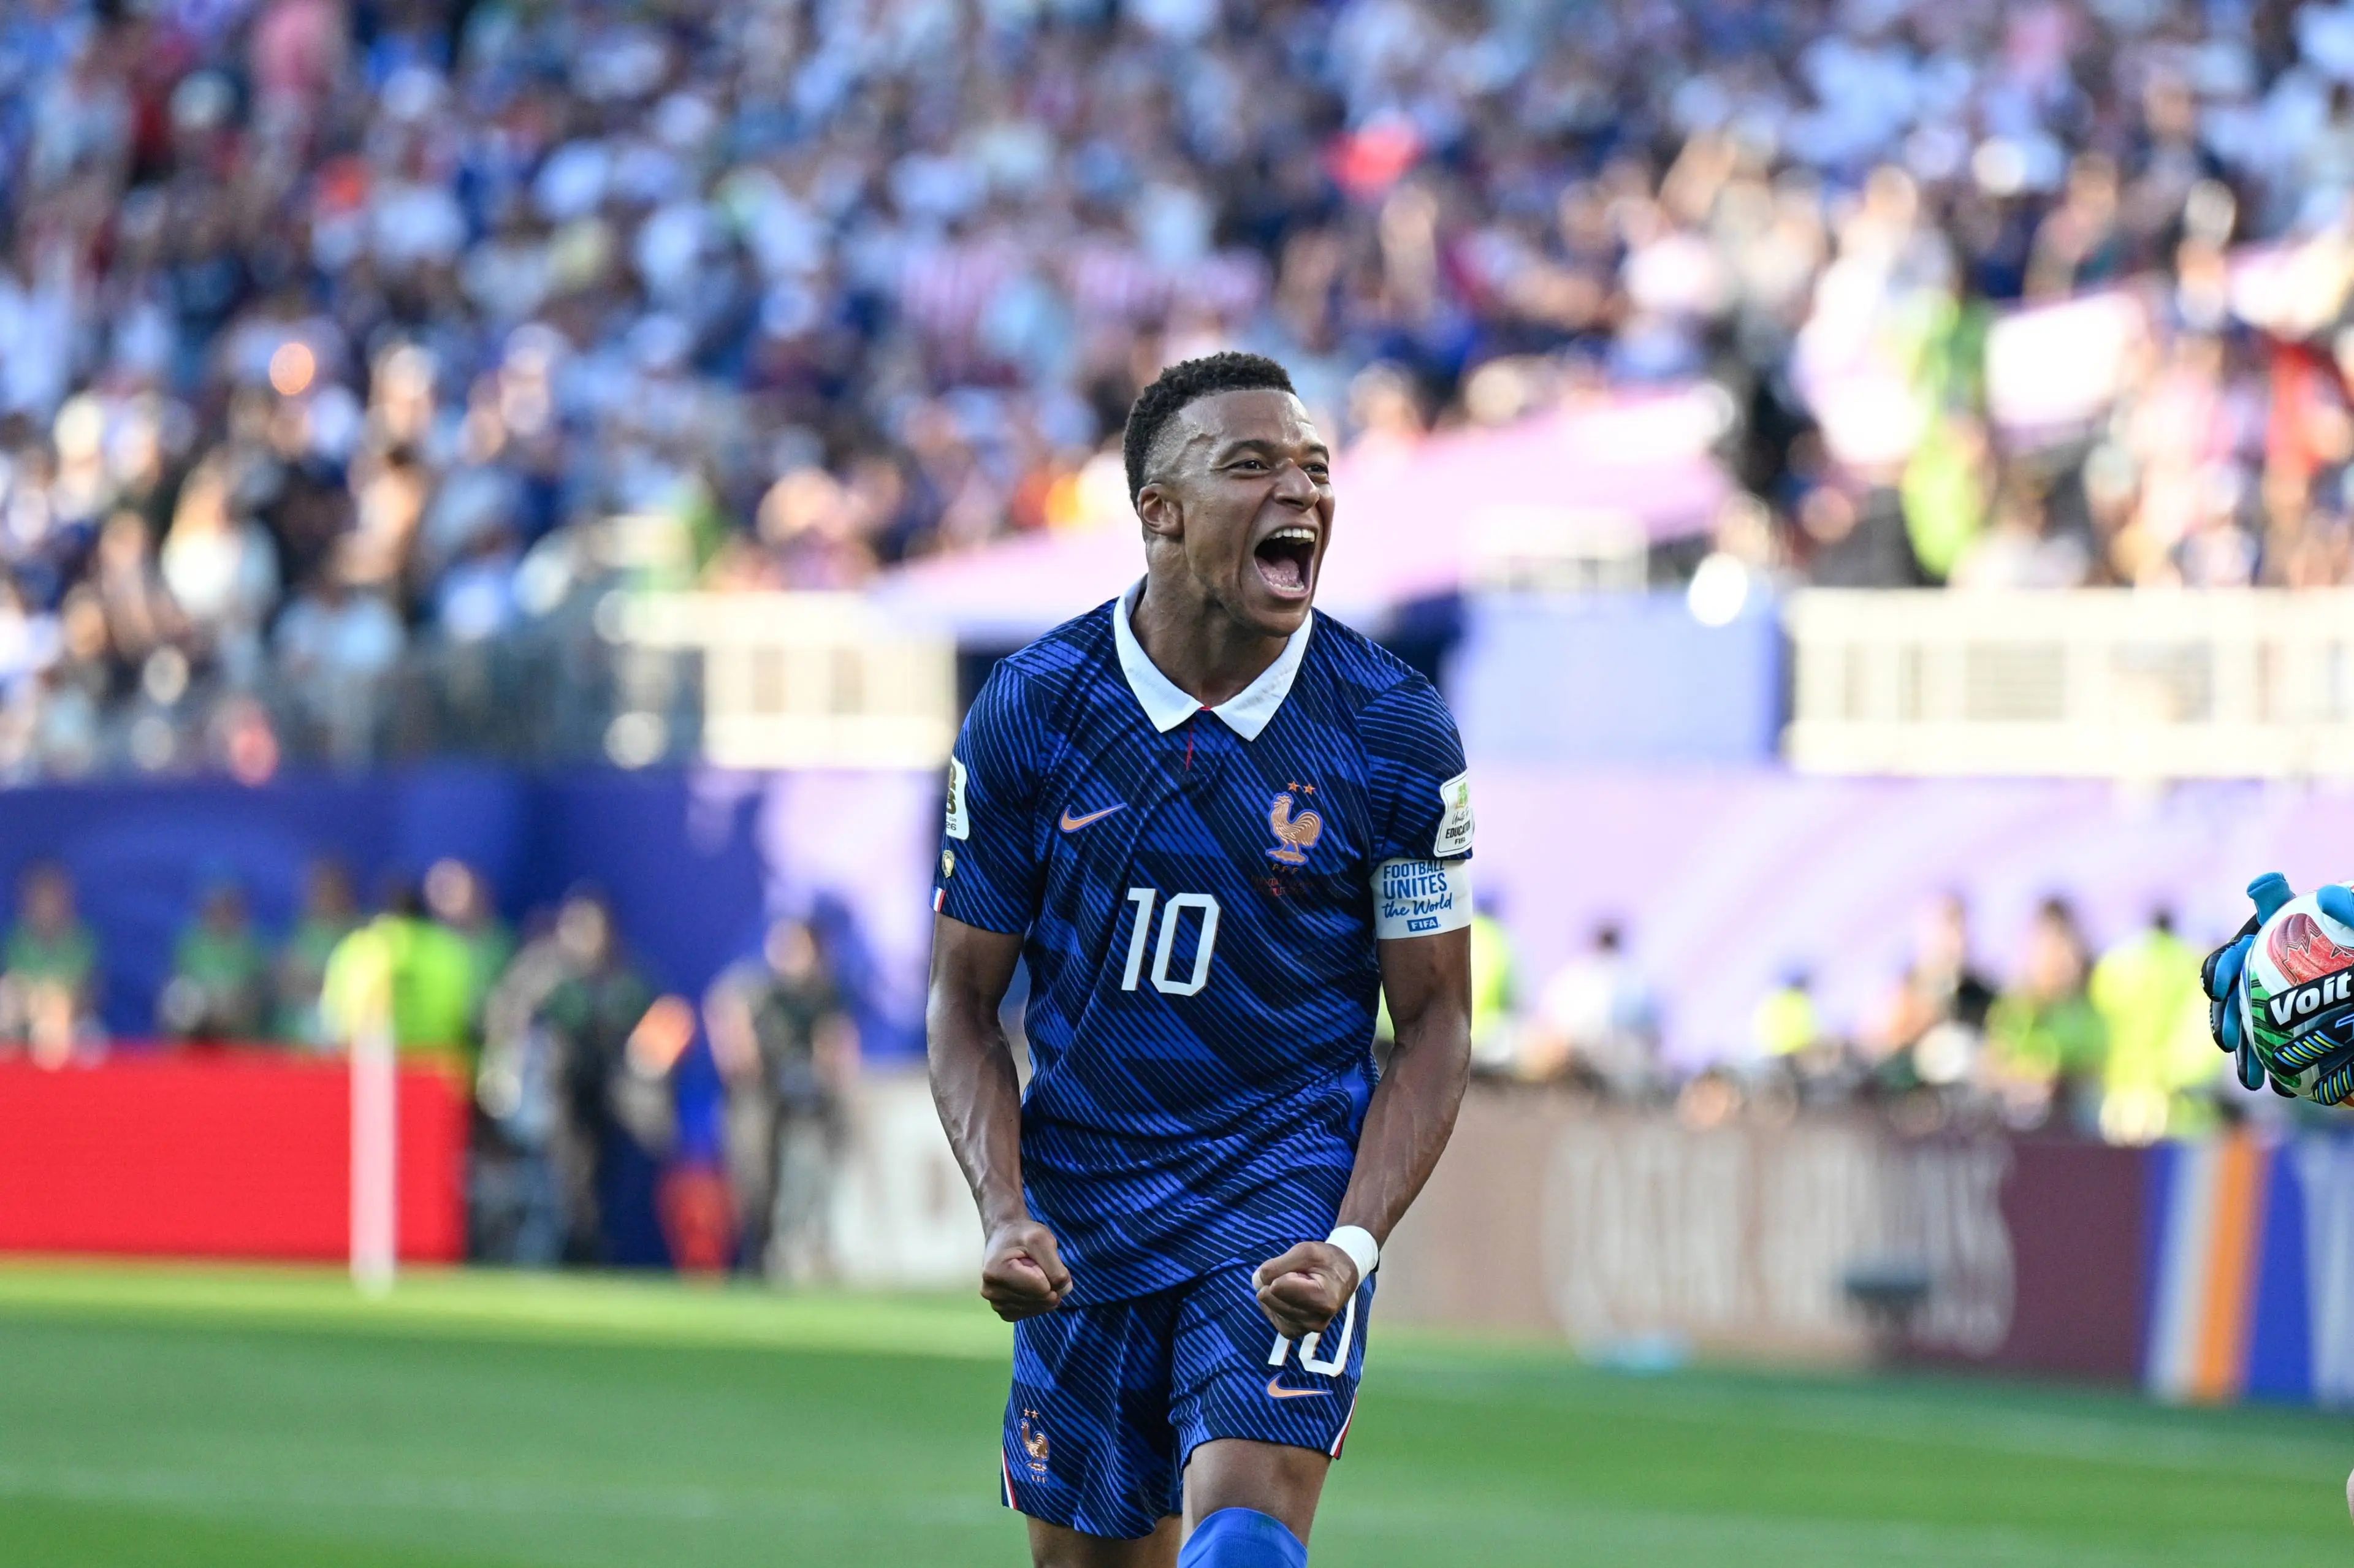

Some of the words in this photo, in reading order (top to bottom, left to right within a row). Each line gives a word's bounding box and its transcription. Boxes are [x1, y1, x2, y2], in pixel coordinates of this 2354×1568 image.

[1383, 859, 1445, 880] FOOTBALL
[1383, 872, 1448, 899] UNITES
[1382, 901, 1410, 919] the
[1412, 892, 1453, 915] World
[1411, 920, 1437, 931] FIFA
[1121, 888, 1221, 997] 10
[2270, 971, 2352, 1026] Voit
